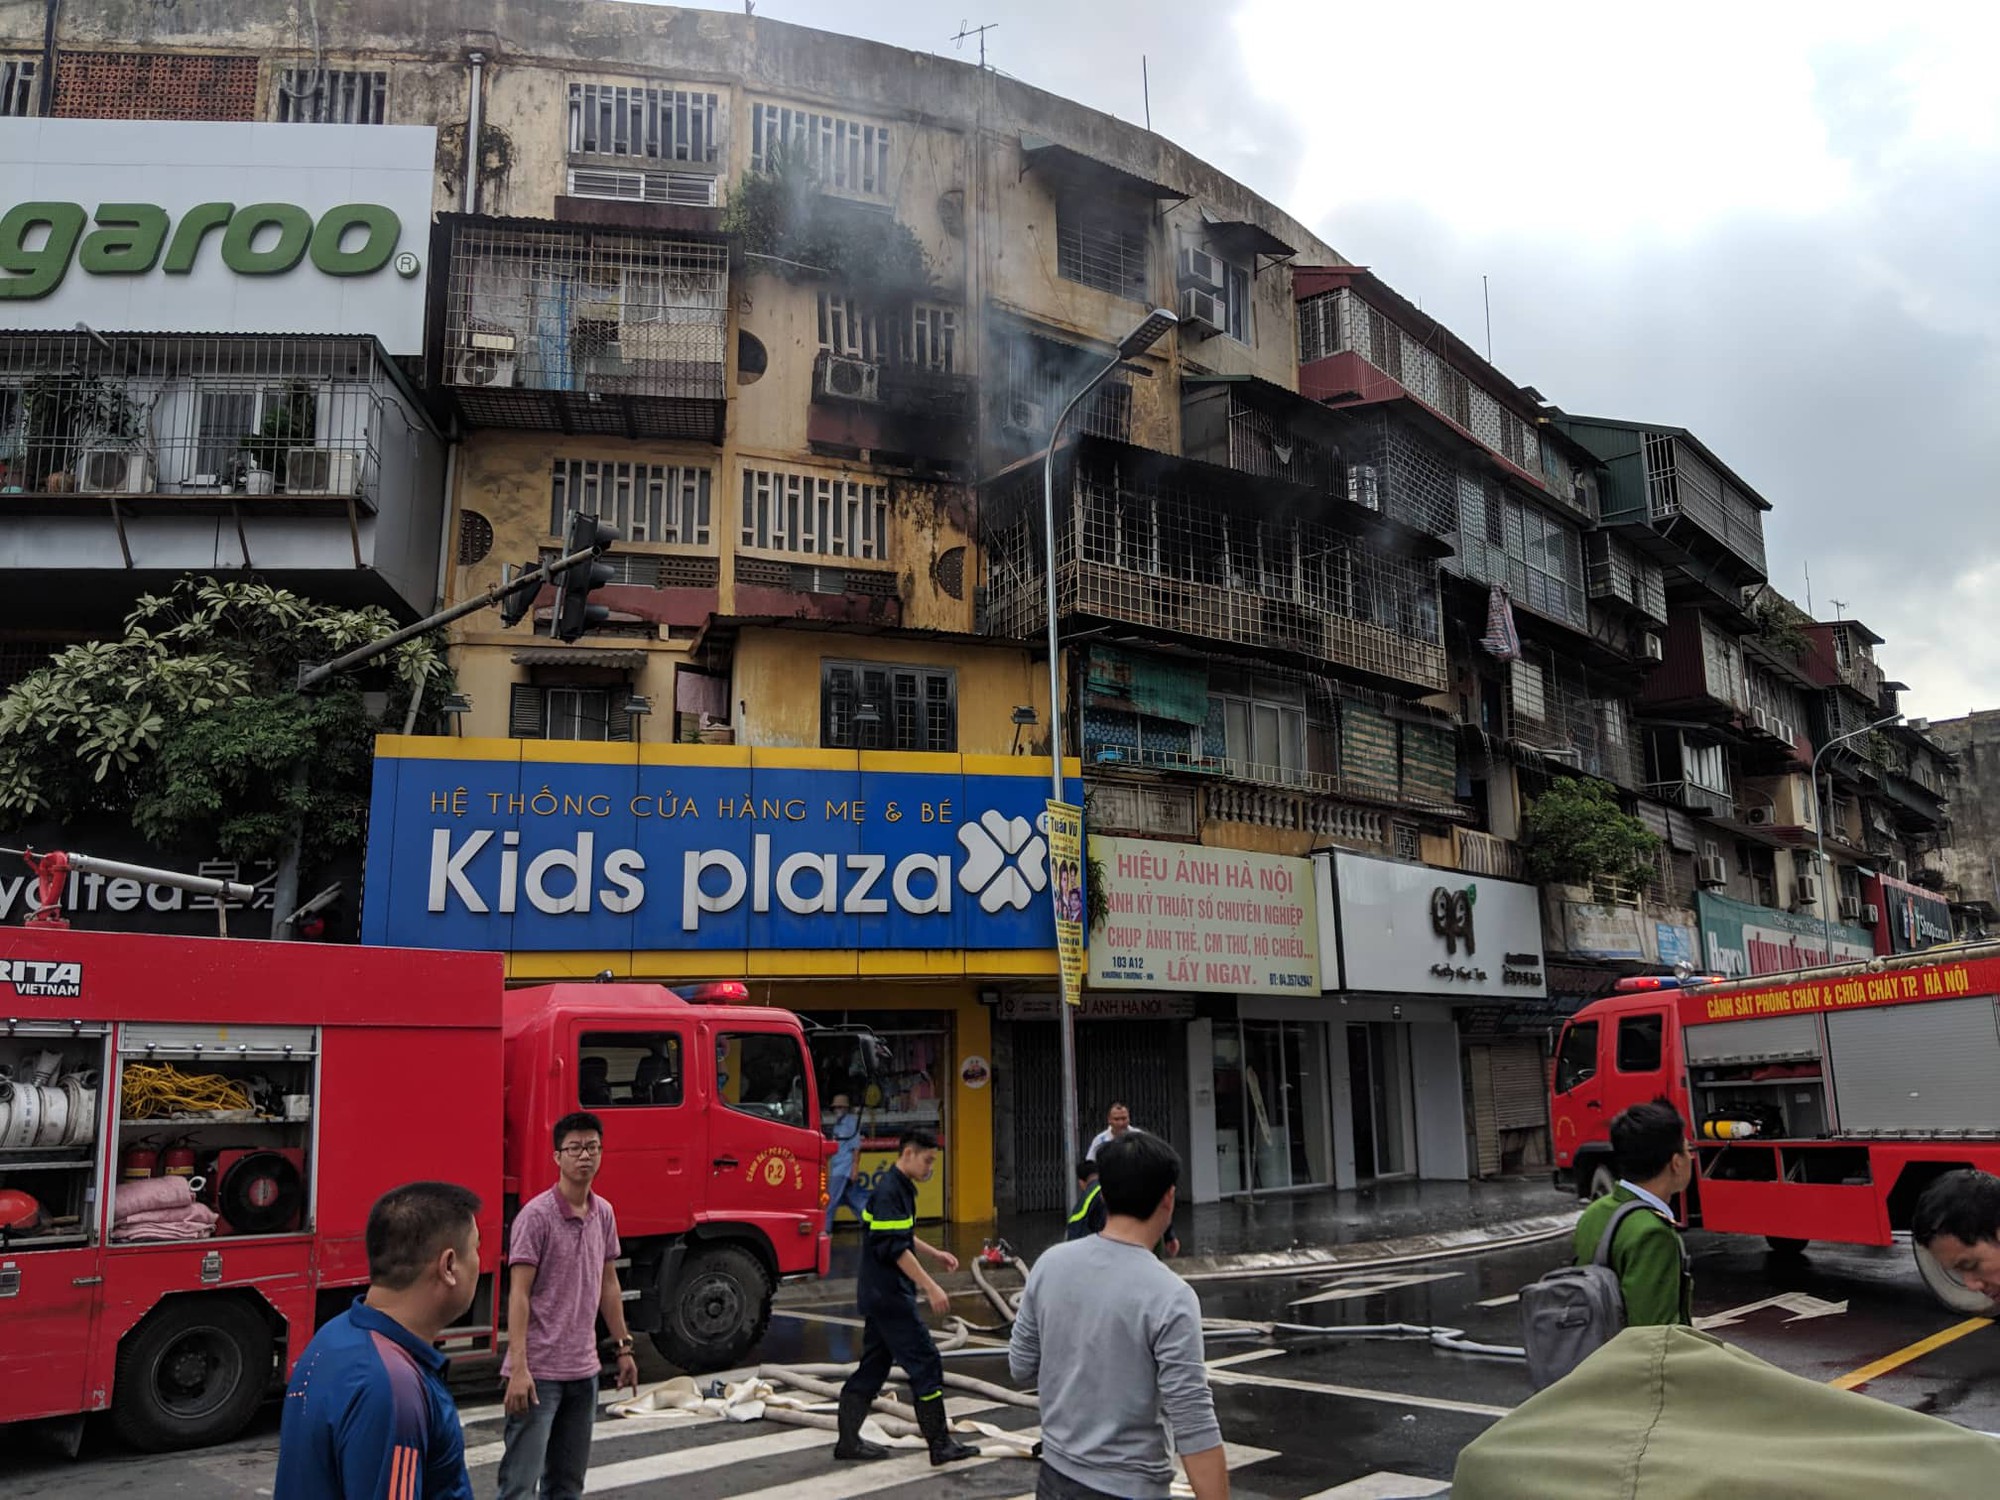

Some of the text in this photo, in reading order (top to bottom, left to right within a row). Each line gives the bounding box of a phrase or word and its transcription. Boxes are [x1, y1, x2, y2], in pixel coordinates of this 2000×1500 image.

[0, 201, 402, 299] garoo
[430, 785, 953, 825] HỆ THỐNG CỬA HÀNG MẸ & BÉ
[428, 828, 951, 931] Kids plaza
[1117, 849, 1167, 887] HIỆU
[1175, 849, 1219, 886] ẢNH
[1226, 860, 1254, 890] HÀ
[1260, 864, 1293, 900] NỘI
[1107, 883, 1134, 914] ẢNH
[1157, 893, 1194, 922] THUẬT
[1199, 893, 1214, 919] SỐ
[1217, 900, 1261, 924] CHUYÊN
[1264, 902, 1303, 930] NGHIỆP
[1107, 926, 1142, 952] CHỤP
[1146, 919, 1172, 949] ẢNH
[1204, 933, 1222, 953] CM
[1253, 933, 1269, 960] HỘ
[1112, 956, 1144, 969] 103 A12
[1167, 953, 1258, 985] LẤY NGAY.
[15, 983, 80, 996] VIETNAM
[1707, 964, 1969, 1018] CẢNH SÁT PHÒNG CHÁY & CHỮA CHÁY TP. HÀ NỘI
[767, 1164, 784, 1180] P.2
